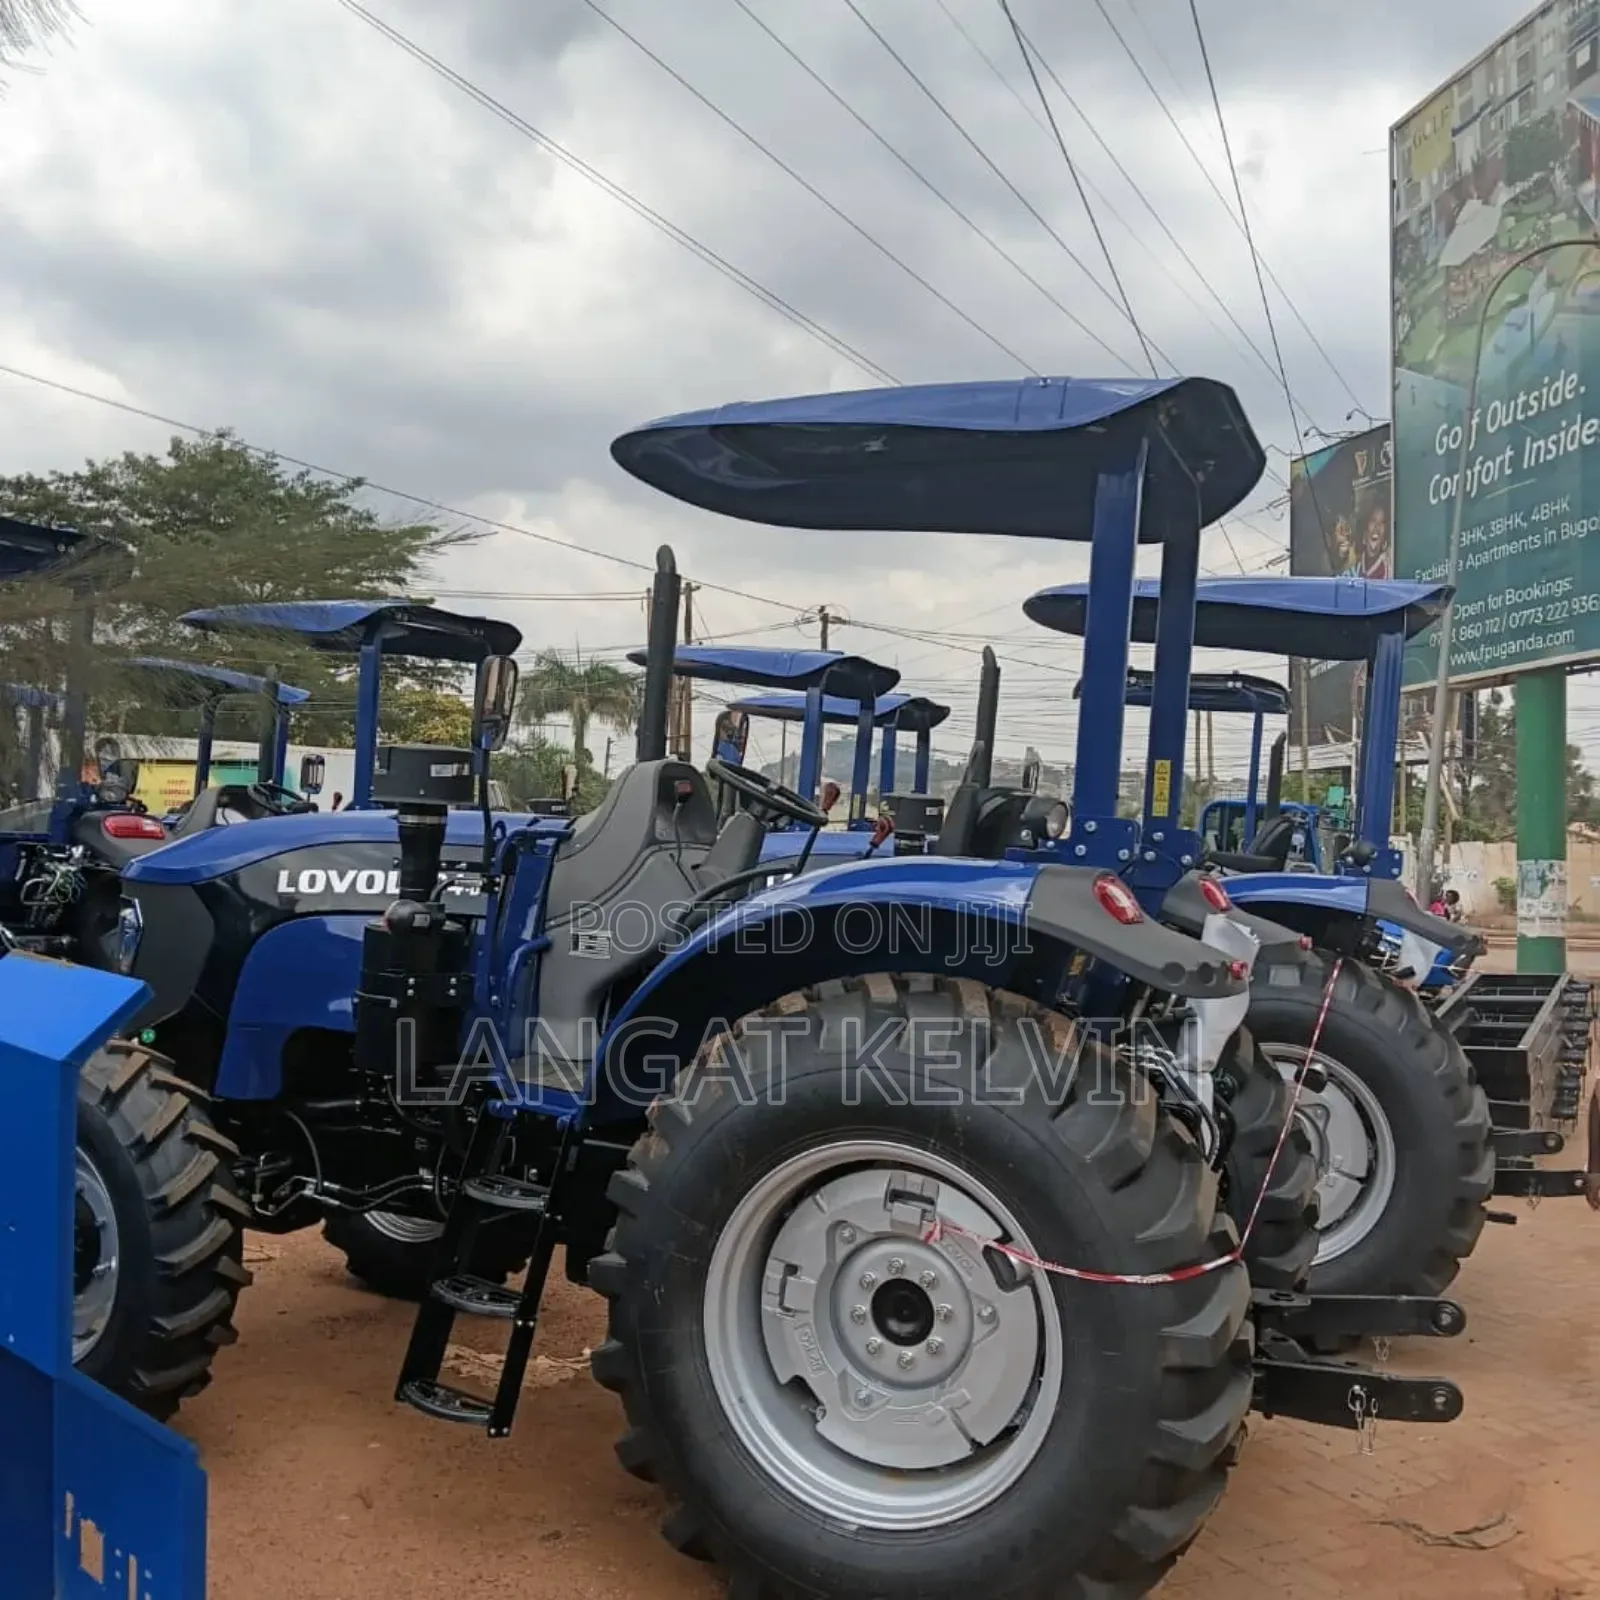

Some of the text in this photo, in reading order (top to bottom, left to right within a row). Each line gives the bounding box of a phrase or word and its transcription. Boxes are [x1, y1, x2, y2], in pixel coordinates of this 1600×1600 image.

[1435, 370, 1586, 456] Gof Outside.
[1531, 495, 1571, 522] 4BHK
[1465, 533, 1542, 570] Apartments
[1544, 527, 1557, 545] in
[1459, 622, 1483, 641] 860
[1509, 607, 1544, 629] 0773
[1545, 600, 1570, 622] 222
